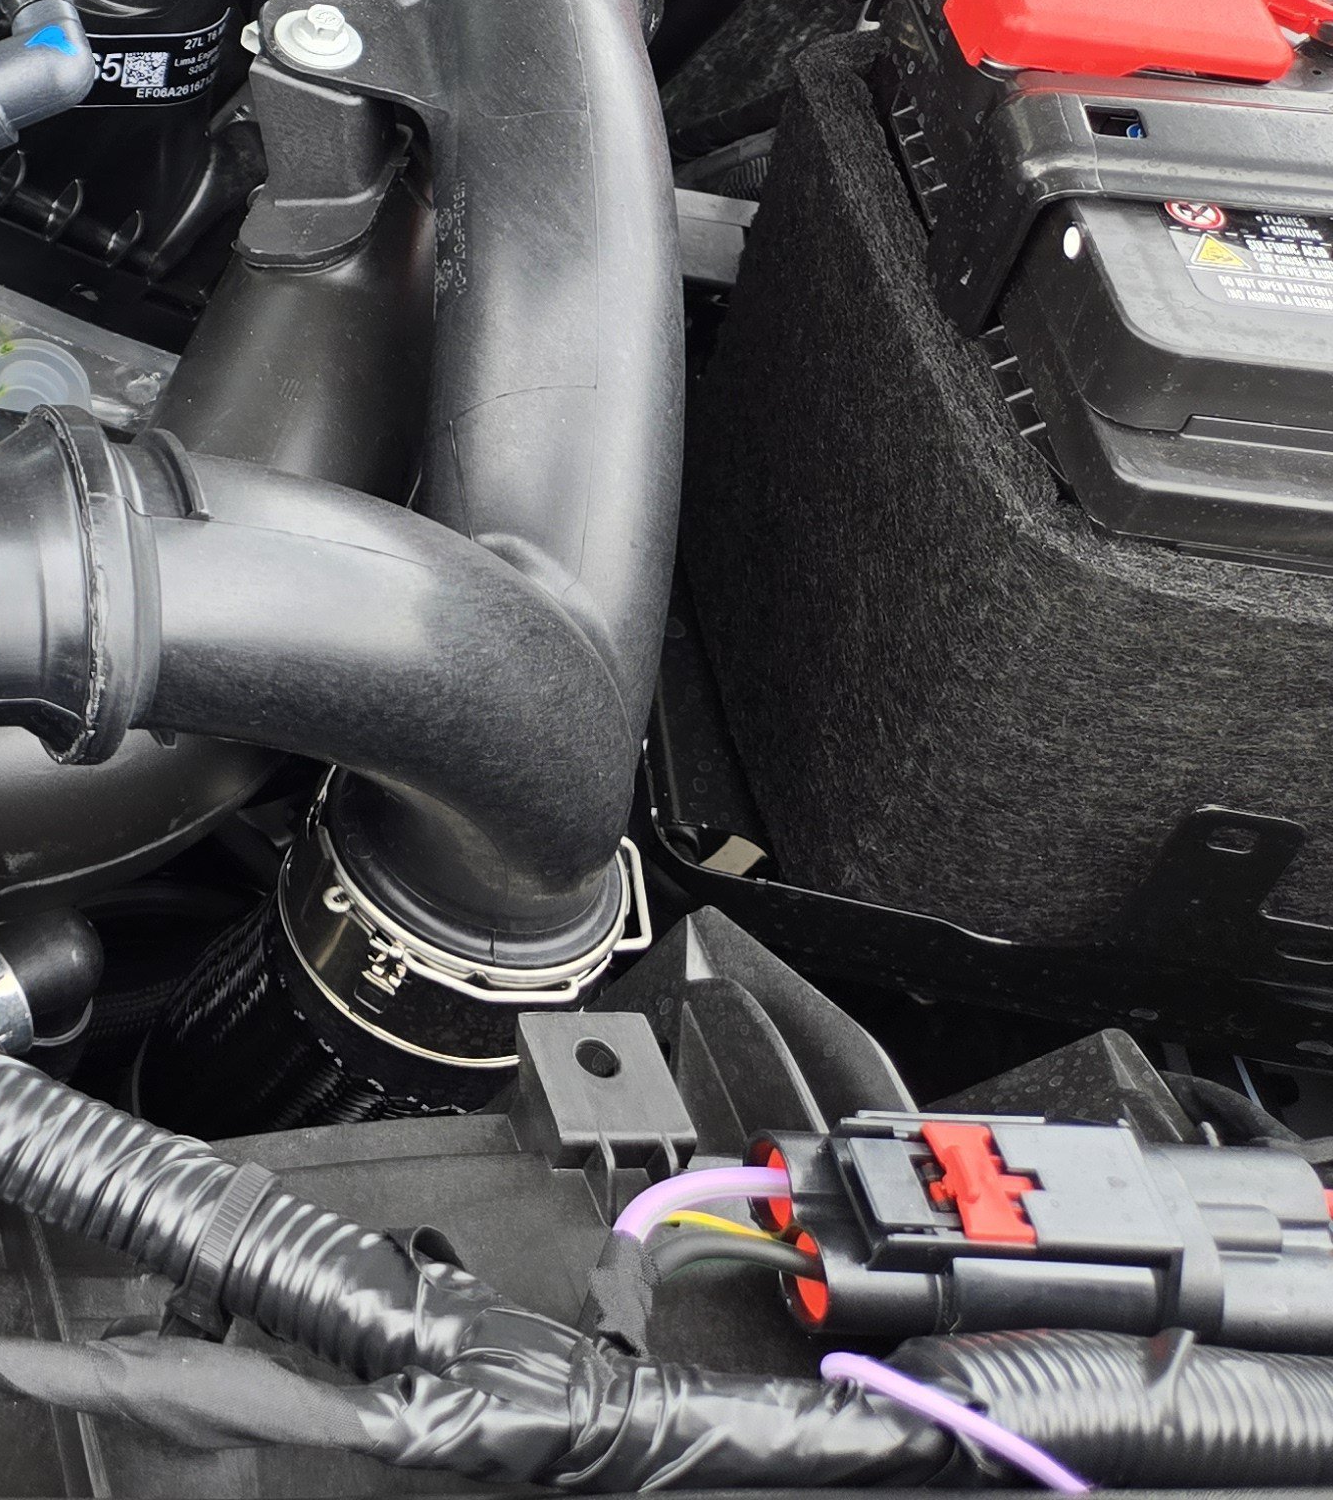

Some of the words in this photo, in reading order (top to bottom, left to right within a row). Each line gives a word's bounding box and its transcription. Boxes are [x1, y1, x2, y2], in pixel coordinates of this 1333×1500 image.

[1263, 214, 1309, 228] FLAMES
[1269, 226, 1323, 241] SMOKING
[1218, 275, 1235, 287] DO
[1235, 277, 1257, 289] NOT
[1257, 280, 1285, 293] OPEN
[1279, 294, 1294, 306] LA
